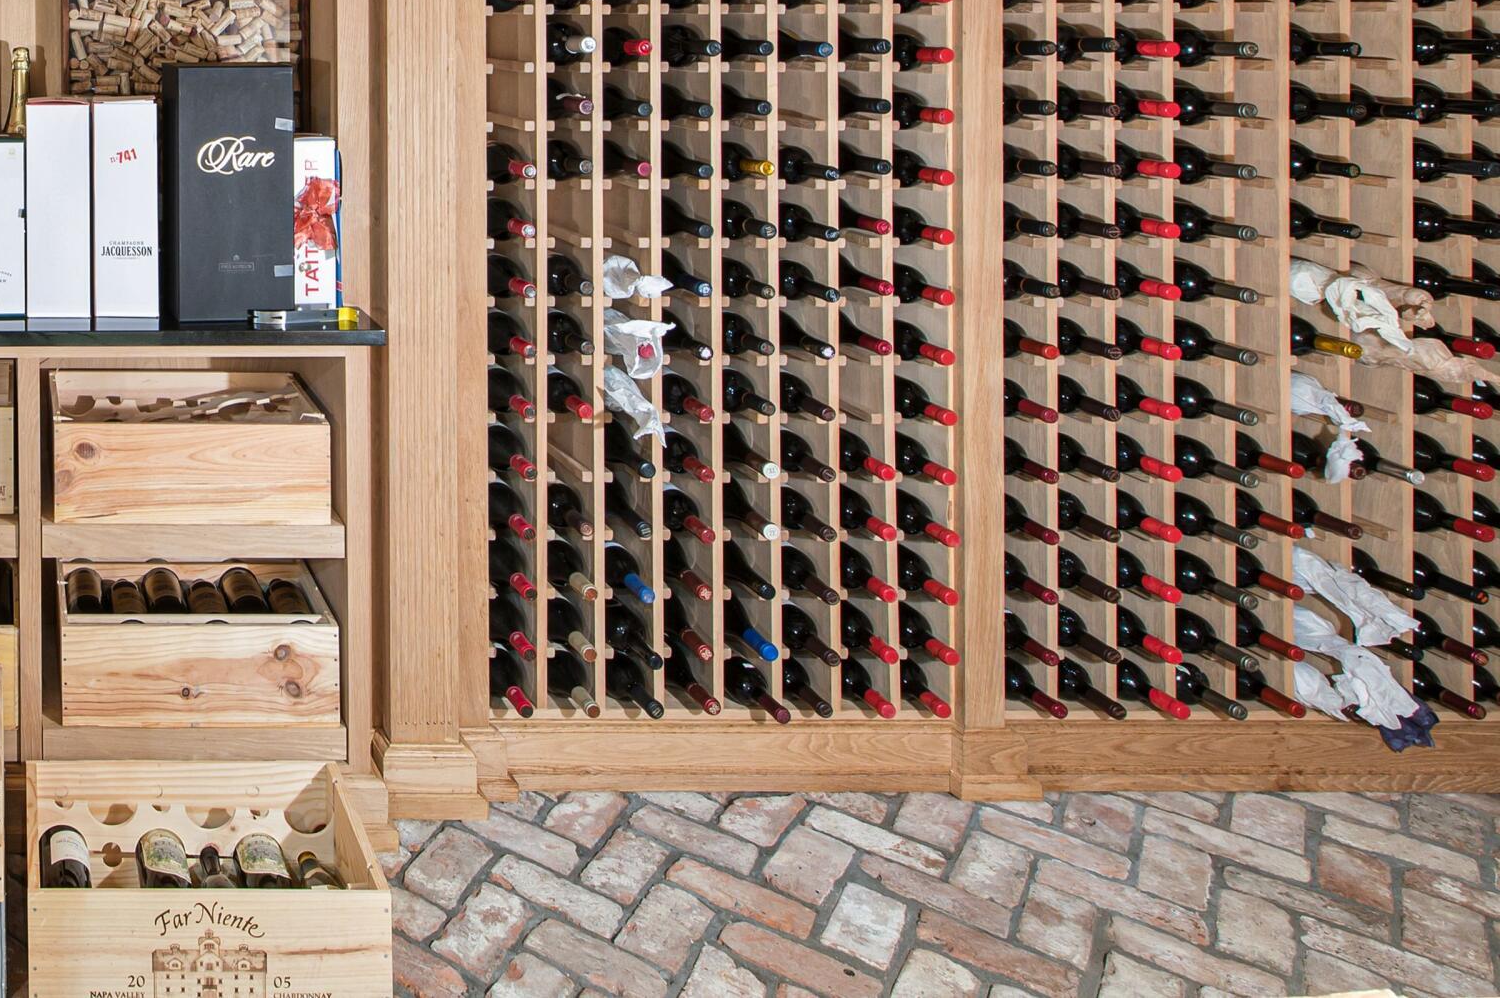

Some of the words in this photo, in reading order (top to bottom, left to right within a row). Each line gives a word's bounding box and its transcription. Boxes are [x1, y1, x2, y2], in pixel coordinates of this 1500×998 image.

[197, 136, 276, 175] Rare
[100, 245, 153, 257] JACQUESSON
[154, 908, 192, 937] Far
[194, 901, 266, 939] Niente
[127, 975, 146, 989] 20
[273, 976, 292, 989] 05
